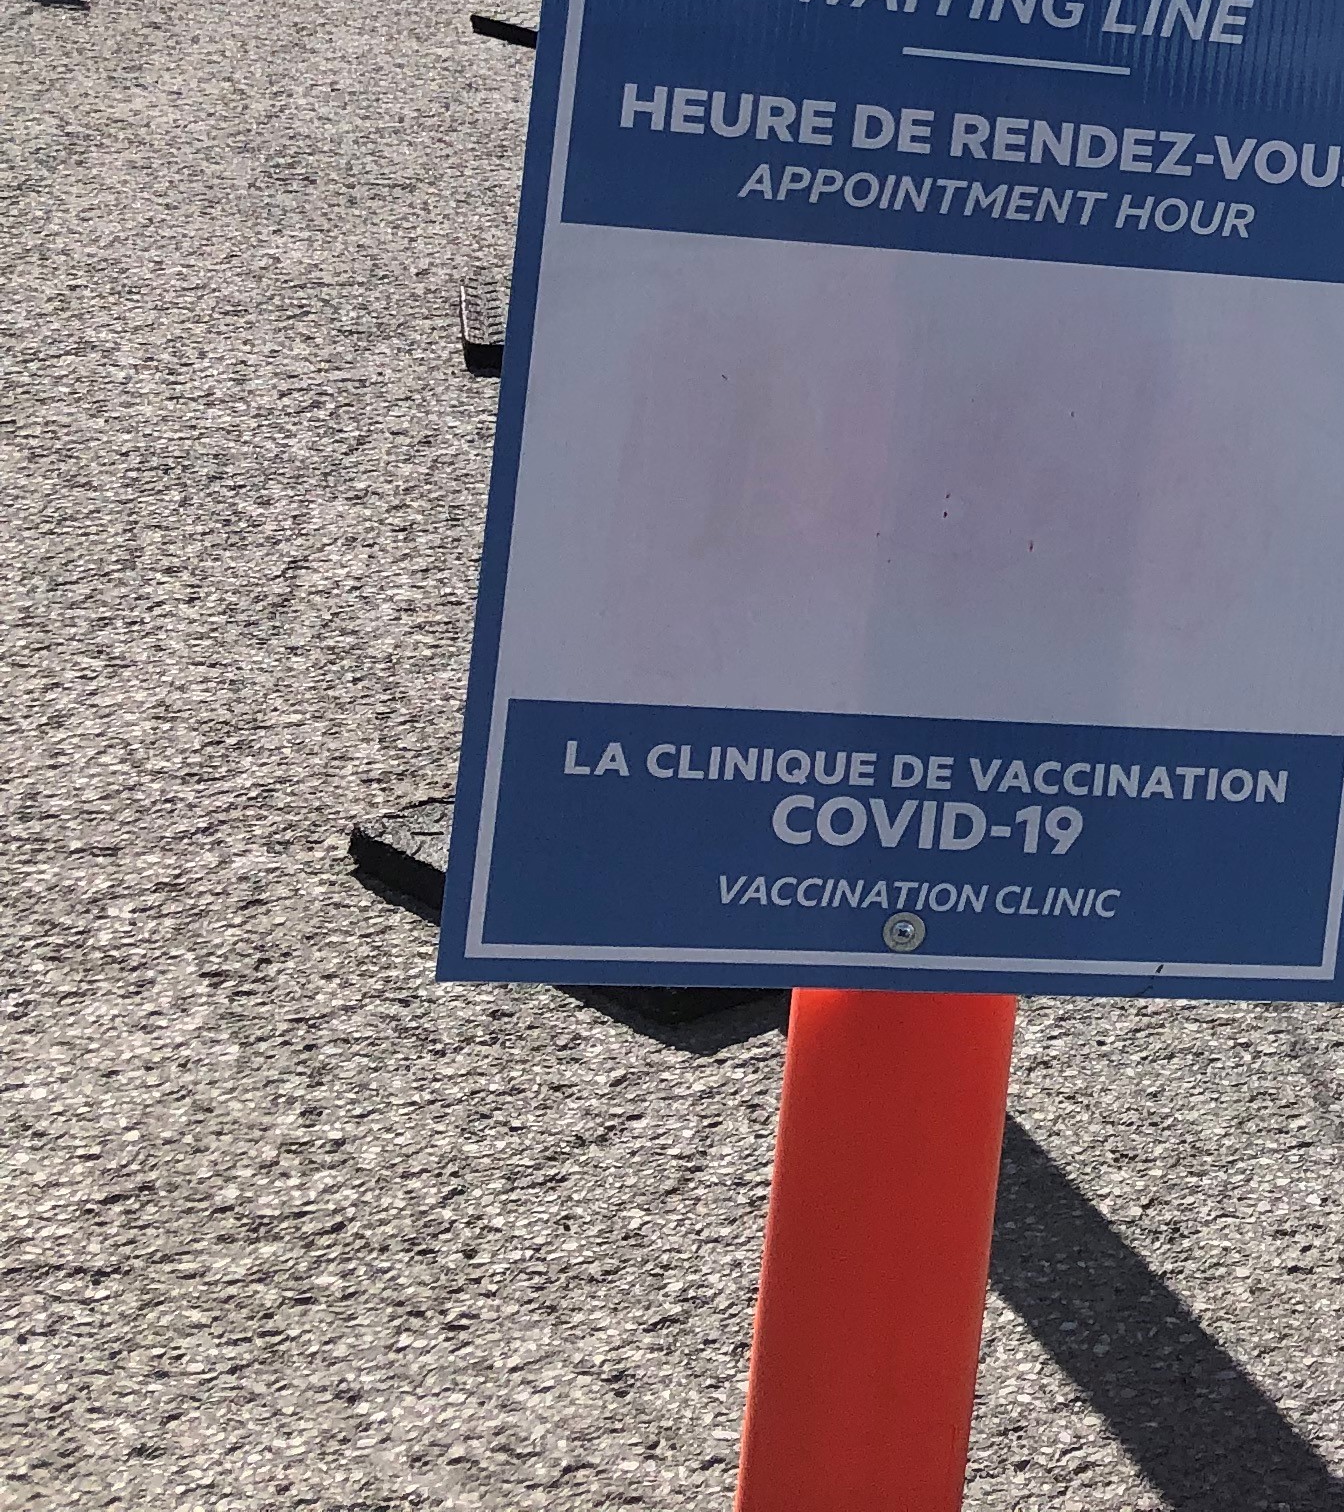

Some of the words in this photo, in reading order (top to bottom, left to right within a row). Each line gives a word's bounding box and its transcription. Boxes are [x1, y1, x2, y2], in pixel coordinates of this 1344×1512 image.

[620, 83, 837, 146] HEURE
[852, 104, 935, 154] DE
[738, 163, 1108, 231] APPOINTMENT
[1116, 191, 1256, 240] HOUR
[563, 740, 630, 776] LA
[646, 743, 877, 788] CLINIQUE
[891, 754, 954, 792] DE
[969, 758, 1288, 804] VACCINATION
[772, 794, 1083, 856] COVID-19
[719, 875, 989, 914] VACCINATION
[995, 885, 1121, 919] CLINIC
